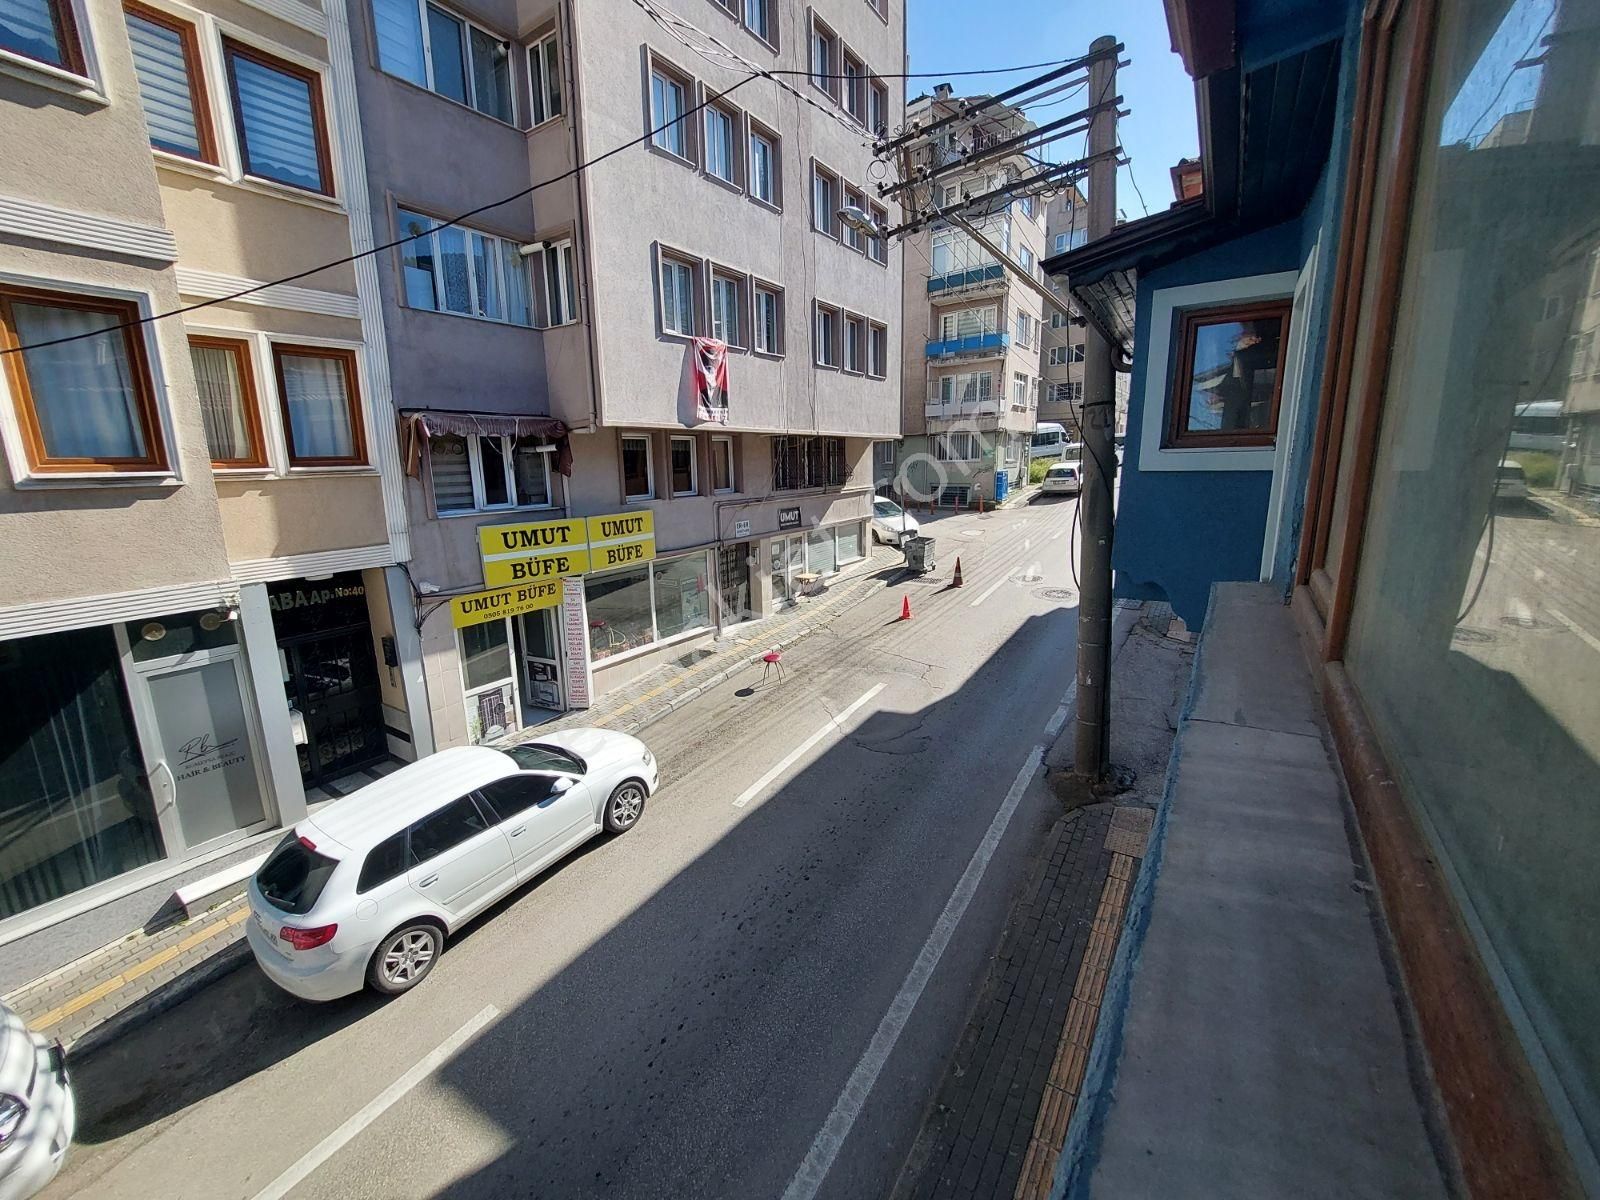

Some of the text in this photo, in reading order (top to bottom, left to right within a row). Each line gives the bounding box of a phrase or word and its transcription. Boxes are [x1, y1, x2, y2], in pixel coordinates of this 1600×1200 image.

[601, 517, 643, 537] UMUT
[780, 510, 799, 523] UMUT
[501, 526, 571, 549] UMUT
[607, 544, 643, 564] BÜFE
[511, 557, 570, 579] BÜFE
[335, 586, 364, 598] No:40
[460, 583, 556, 614] UMUT BÜFE
[176, 769, 202, 782] HAIR
[212, 755, 246, 770] BEAUTY
